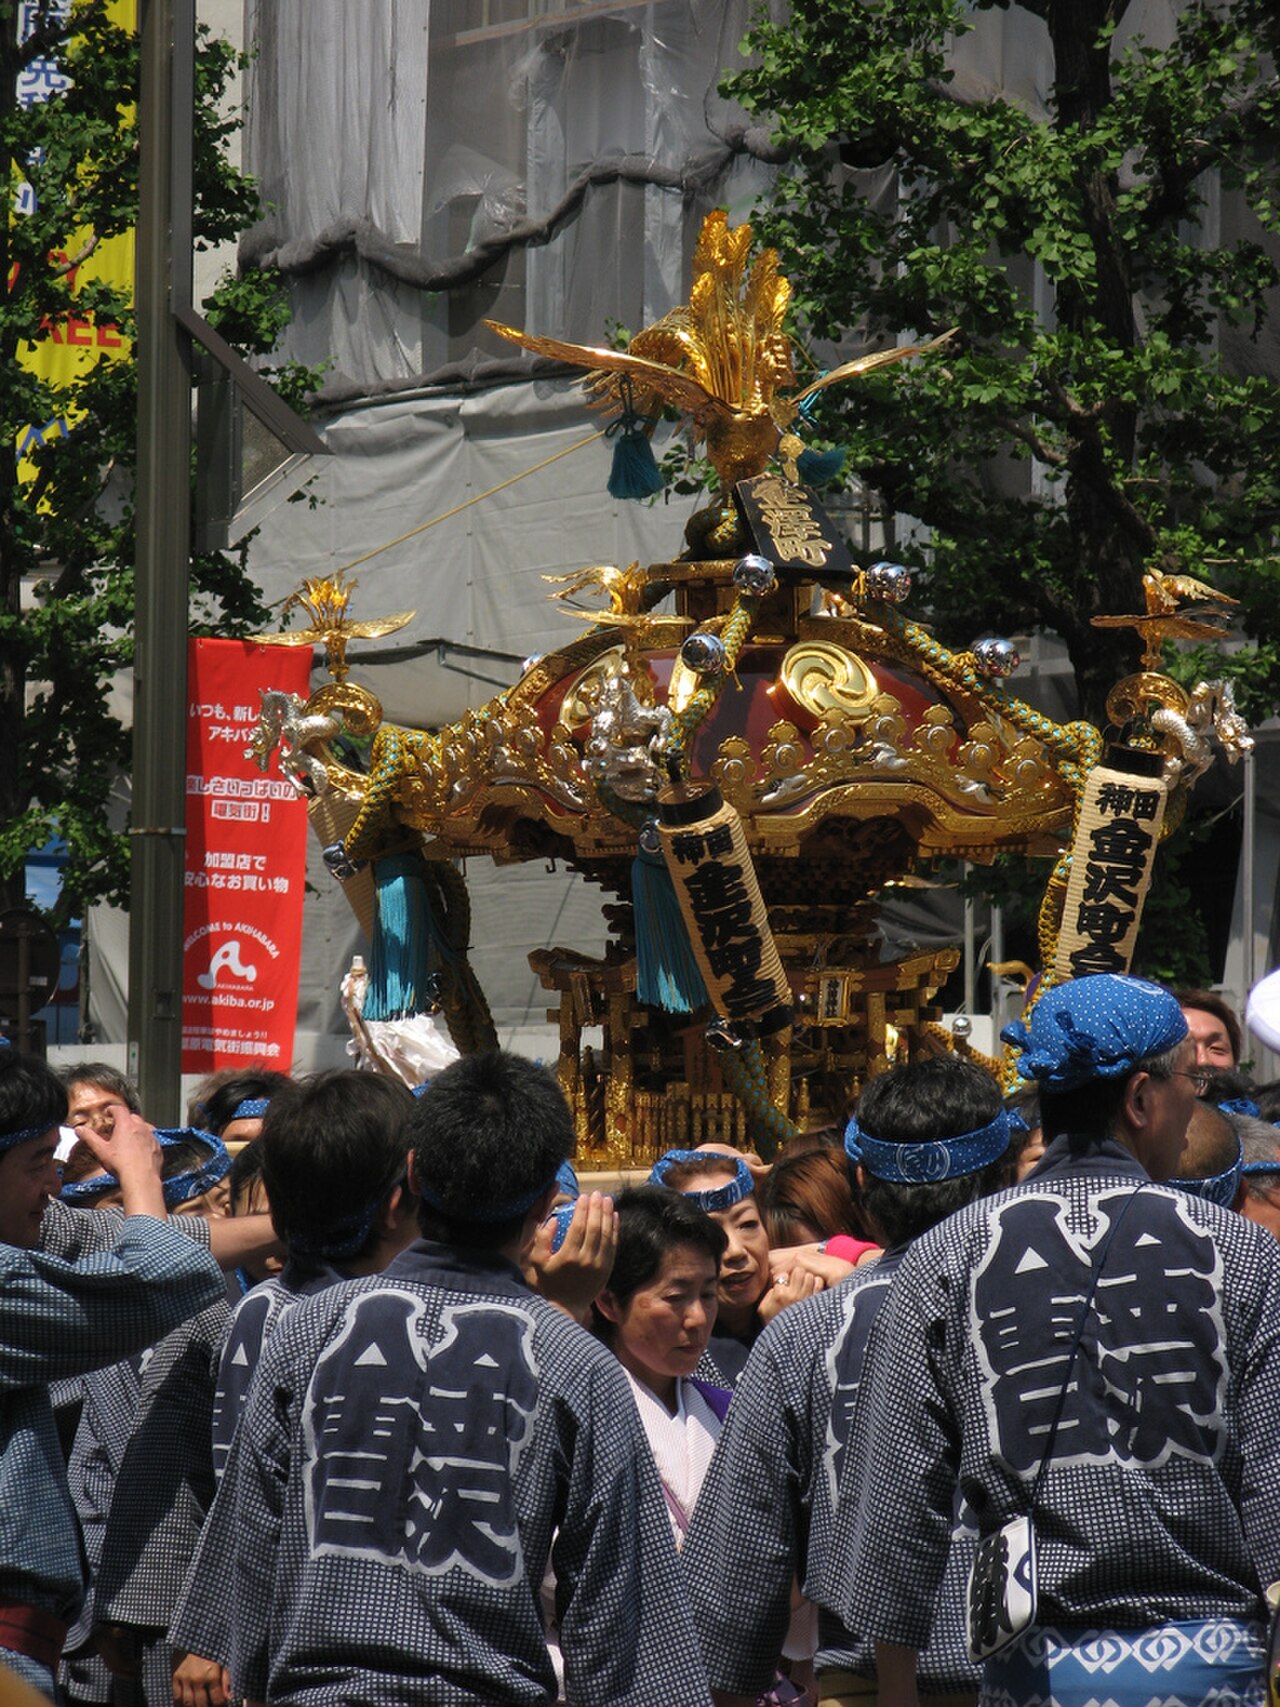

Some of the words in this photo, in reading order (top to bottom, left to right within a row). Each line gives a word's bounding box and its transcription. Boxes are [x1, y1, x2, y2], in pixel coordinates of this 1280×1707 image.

[190, 703, 263, 723] いつも、新し
[1094, 783, 1161, 820] 神田
[671, 823, 734, 865] 神田
[204, 851, 267, 871] 加盟店で
[184, 871, 290, 894] 安心なお買い物
[222, 921, 233, 932] to
[234, 922, 280, 960] AKIHABARA
[182, 994, 275, 1011] www.akiba.or.jp
